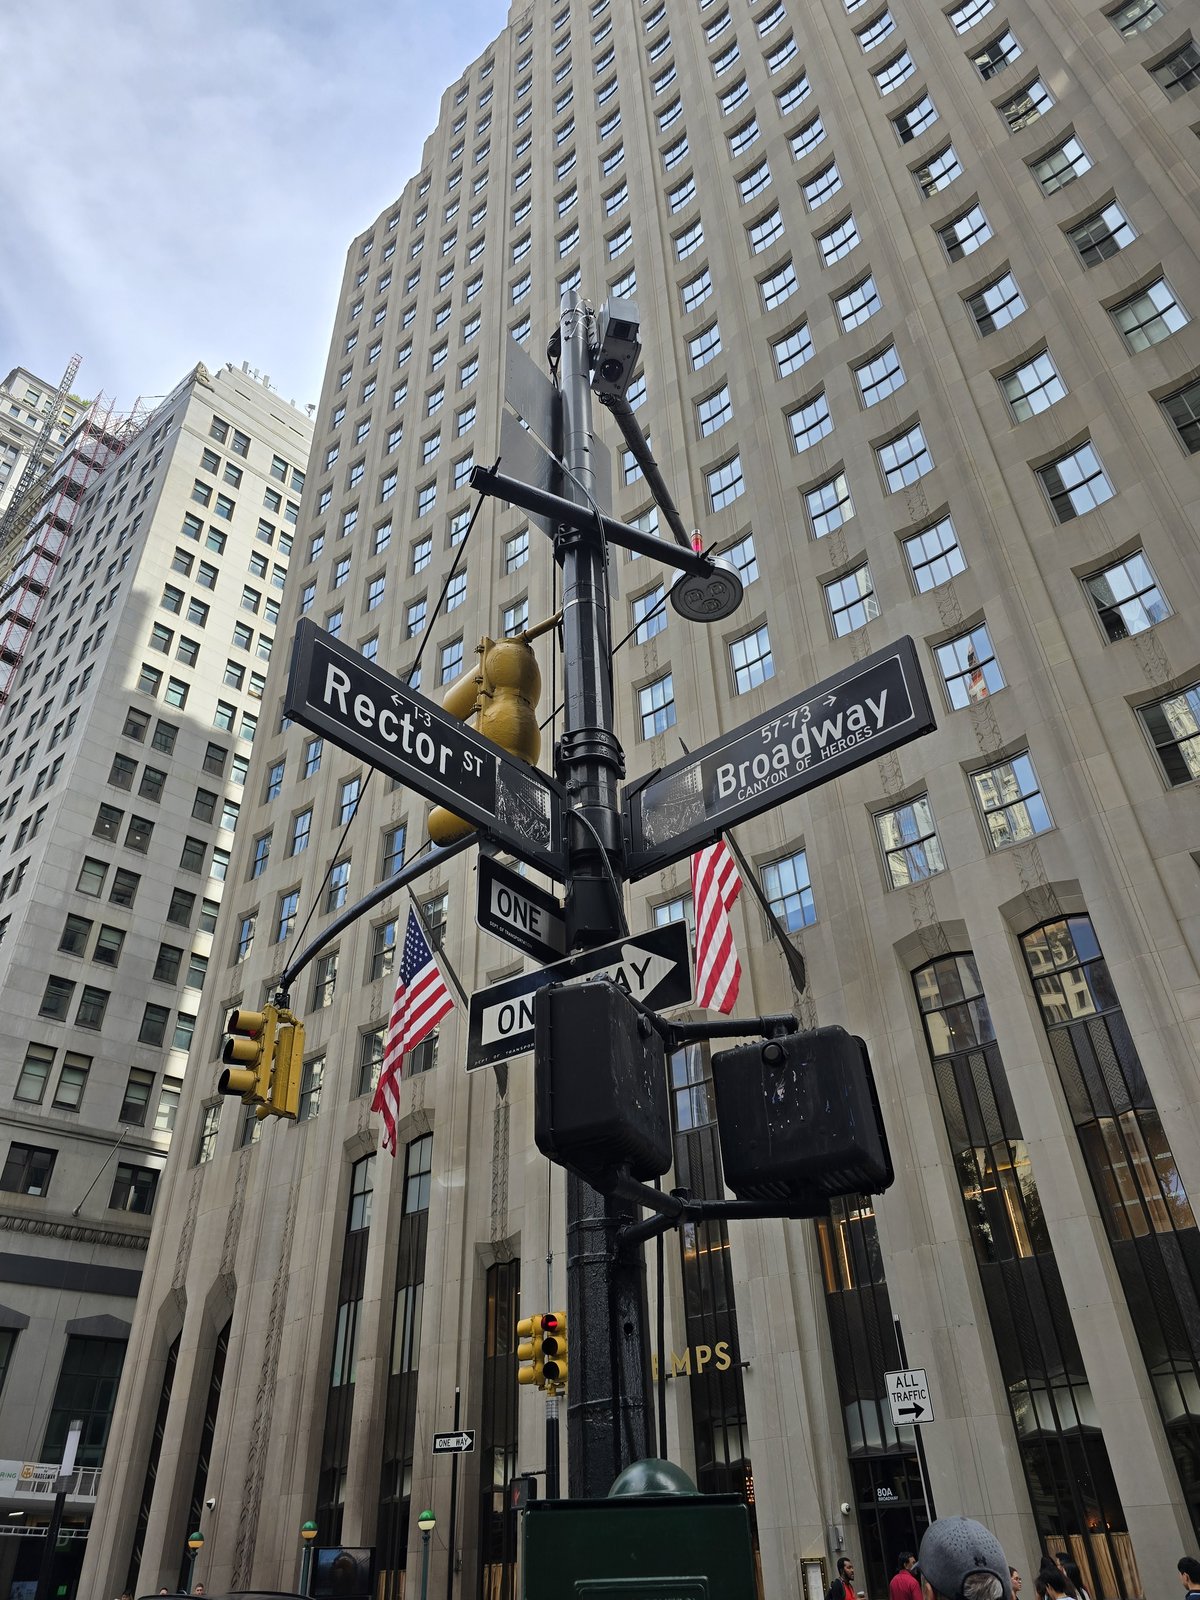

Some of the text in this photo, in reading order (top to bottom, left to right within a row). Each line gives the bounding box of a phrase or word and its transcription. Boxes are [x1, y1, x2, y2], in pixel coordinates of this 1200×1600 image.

[323, 662, 483, 777] Rector ST
[414, 706, 431, 728] 1-3
[761, 705, 812, 744] 57-73
[716, 689, 888, 799] Broadway
[737, 726, 873, 801] CANYON OF HEROES
[497, 888, 542, 937] ONE
[498, 956, 652, 1035] ON AY
[505, 1042, 535, 1054] TRANSPOR
[891, 1389, 927, 1403] TRAFFIC
[896, 1374, 919, 1388] ALL
[438, 1437, 469, 1448] ONE WAY
[876, 1487, 893, 1497] 80A
